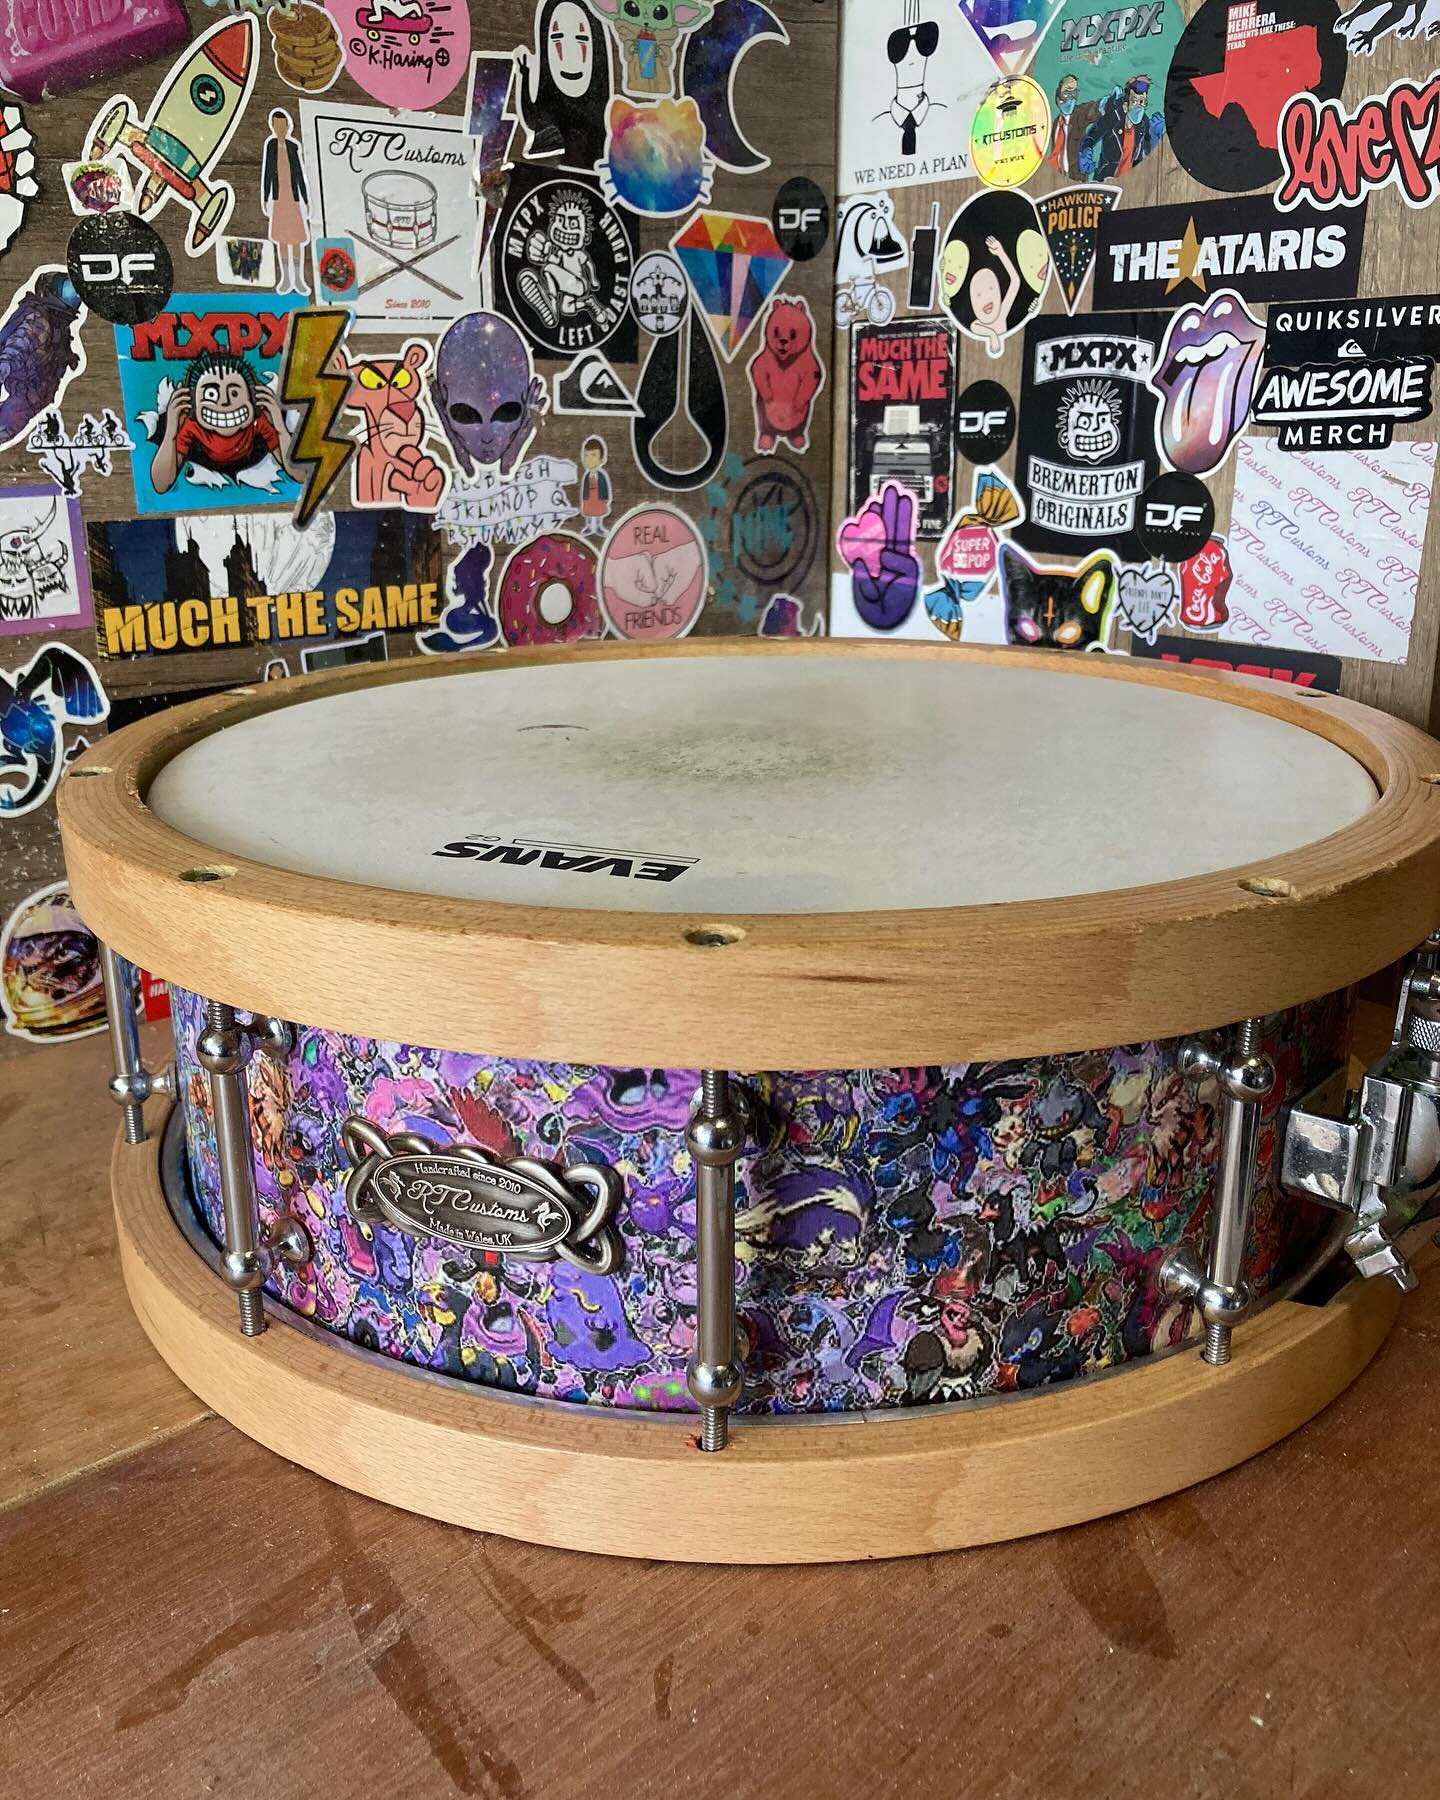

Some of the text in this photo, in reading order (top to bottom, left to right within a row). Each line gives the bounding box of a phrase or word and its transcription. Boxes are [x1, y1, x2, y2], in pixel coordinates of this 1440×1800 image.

[1060, 1, 1164, 51] MXPX
[1228, 12, 1276, 34] HERRERA
[1229, 4, 1257, 20] MIKE
[1227, 20, 1297, 42] MOMENTS LIKE THESE:
[1227, 40, 1246, 50] TEXAS
[854, 153, 969, 184] WE NEED A PLAN
[1048, 193, 1105, 211] HAWKINS
[508, 195, 545, 258] MXPX
[779, 208, 821, 232] DF
[1109, 224, 1347, 282] THE ATARIS
[79, 253, 155, 285] DF
[558, 324, 595, 347] LEFT
[599, 211, 629, 264] PUNK
[1276, 304, 1440, 333] QUIKSILVER
[131, 311, 290, 360] MXPX
[860, 332, 949, 361] MUCH THE
[1050, 341, 1137, 371] MXPX
[858, 359, 948, 403] SAME
[1258, 364, 1427, 410] AWESOME
[959, 410, 1007, 436] DF
[1284, 424, 1386, 446] MERCH
[1033, 463, 1139, 497] BREMERTON
[1036, 498, 1128, 531] ORIGINALS
[1145, 503, 1203, 531] DF
[633, 525, 670, 545] REAL
[954, 537, 991, 553] SUPER
[968, 553, 991, 569] POP
[103, 582, 442, 655] MUCH THE SAME
[624, 606, 683, 631] FRIENDS
[431, 841, 691, 882] EVANS
[414, 1162, 522, 1195] Handcrafted since 2010
[429, 1217, 455, 1237] Made
[456, 1228, 465, 1240] in
